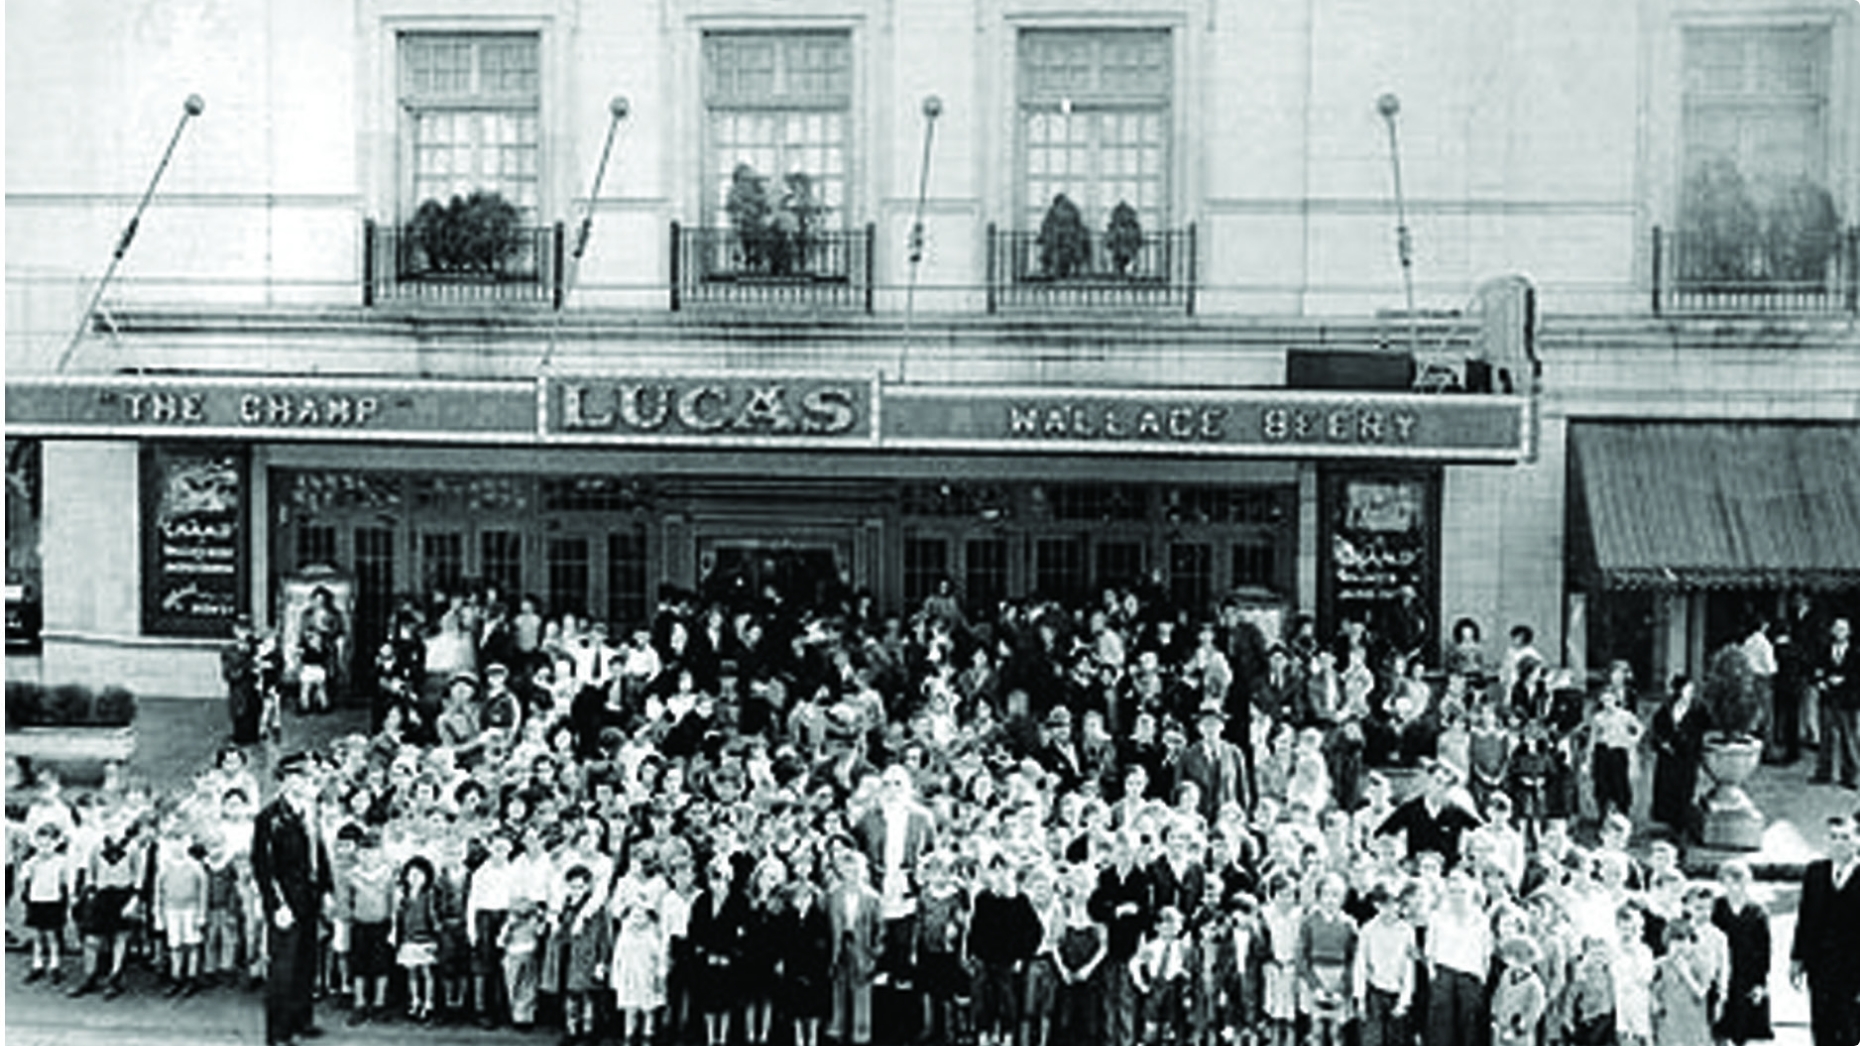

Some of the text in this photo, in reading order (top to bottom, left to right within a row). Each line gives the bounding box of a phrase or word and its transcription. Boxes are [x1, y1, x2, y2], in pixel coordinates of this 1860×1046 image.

[560, 382, 857, 434] LUCAS
[1010, 404, 1418, 440] WALLACE BEERY
